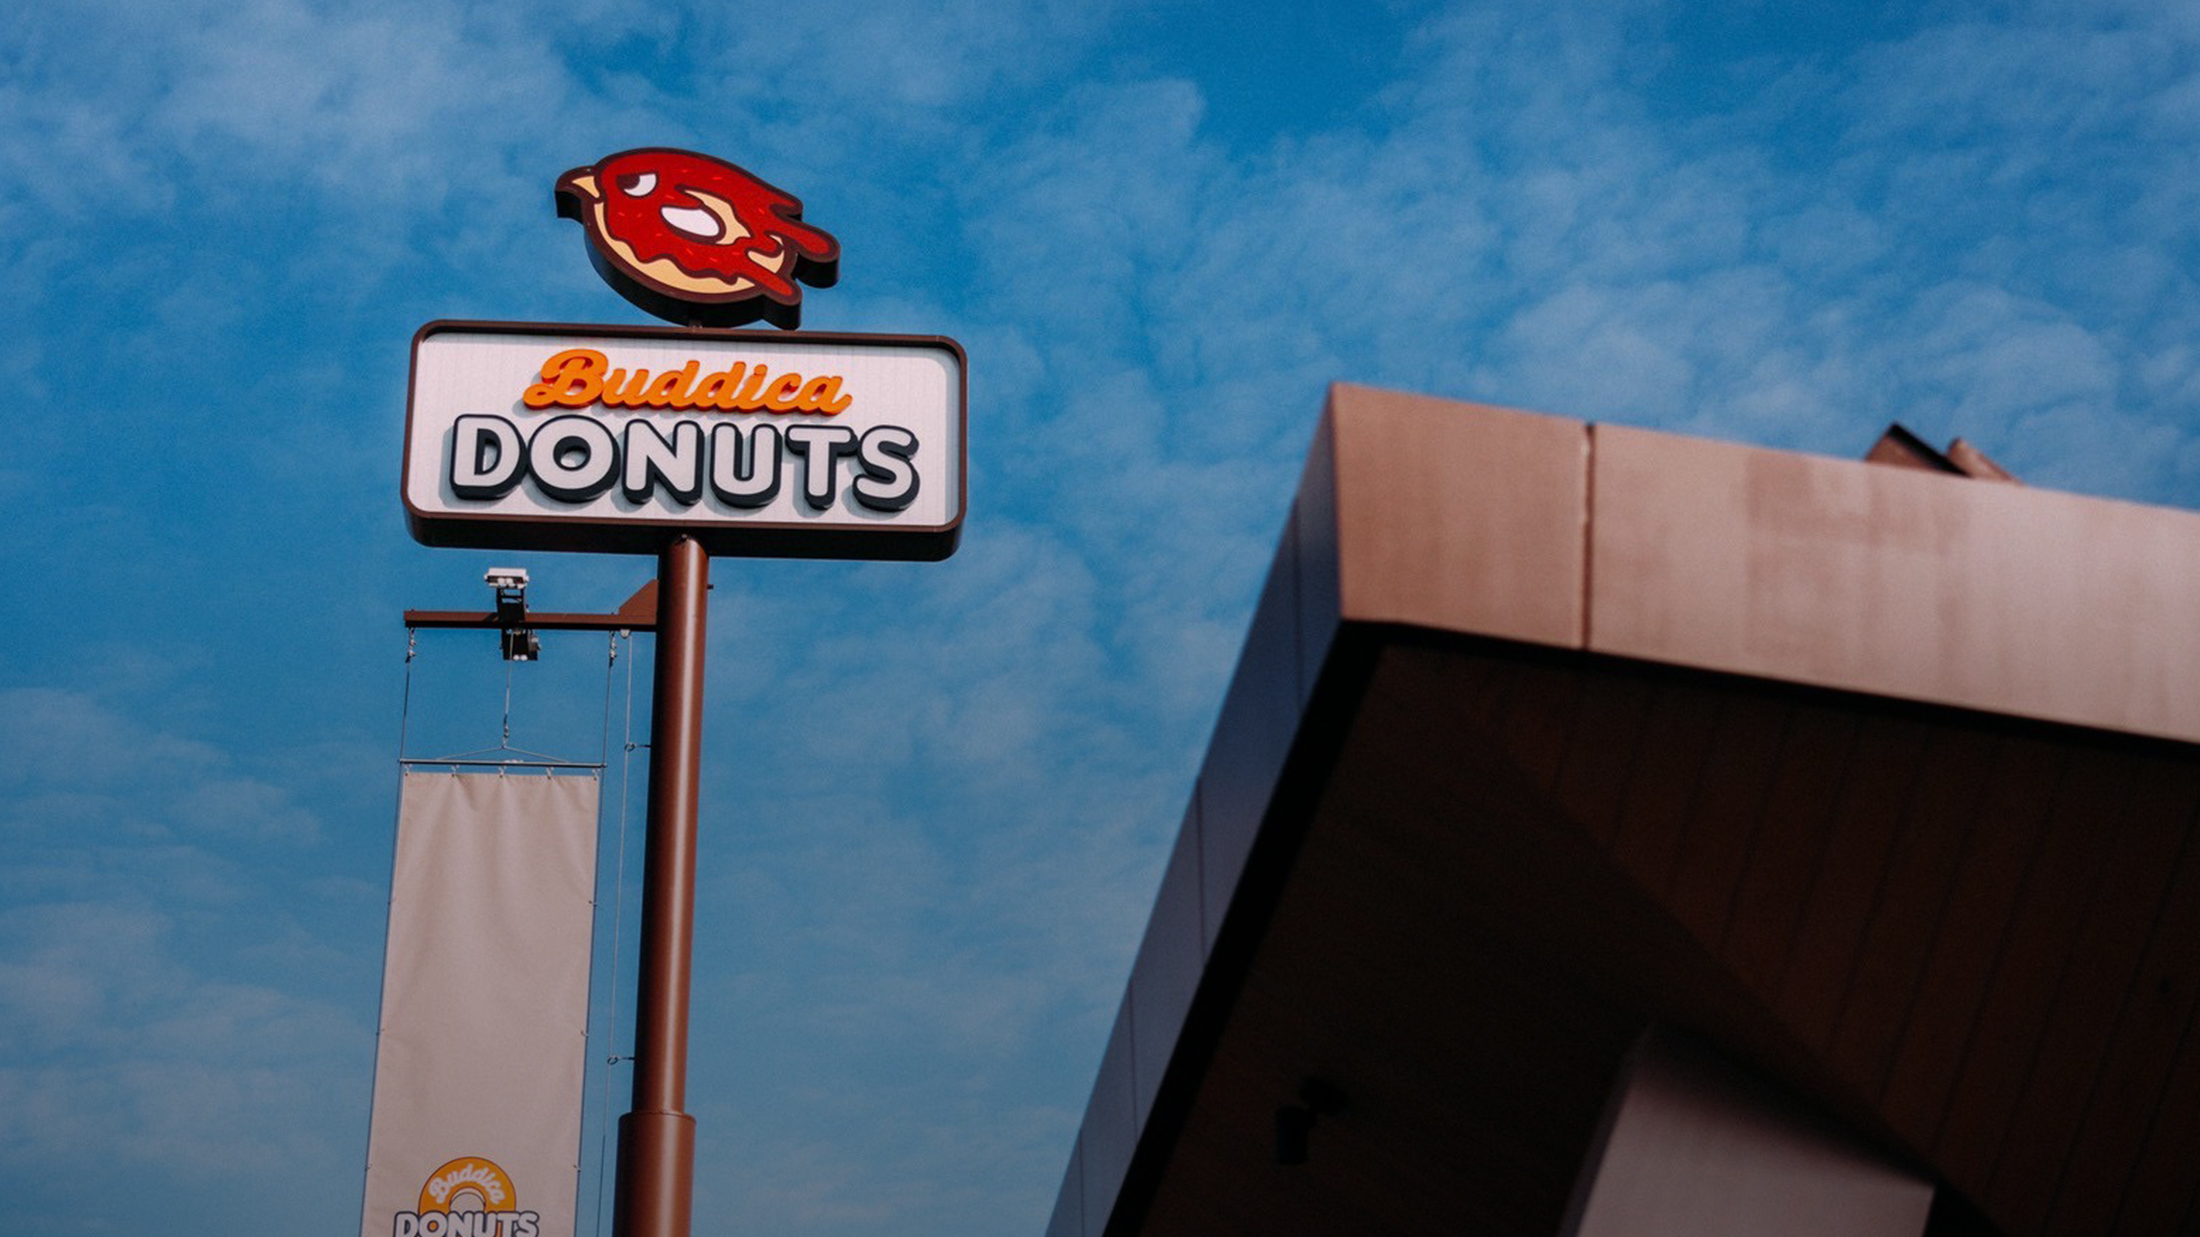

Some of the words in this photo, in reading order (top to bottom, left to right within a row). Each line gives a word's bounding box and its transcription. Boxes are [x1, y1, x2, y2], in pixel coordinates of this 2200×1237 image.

[522, 348, 854, 416] Buddica
[450, 414, 921, 512] DONUTS
[428, 1163, 506, 1205] Buddica
[394, 1210, 540, 1237] DONUTS
